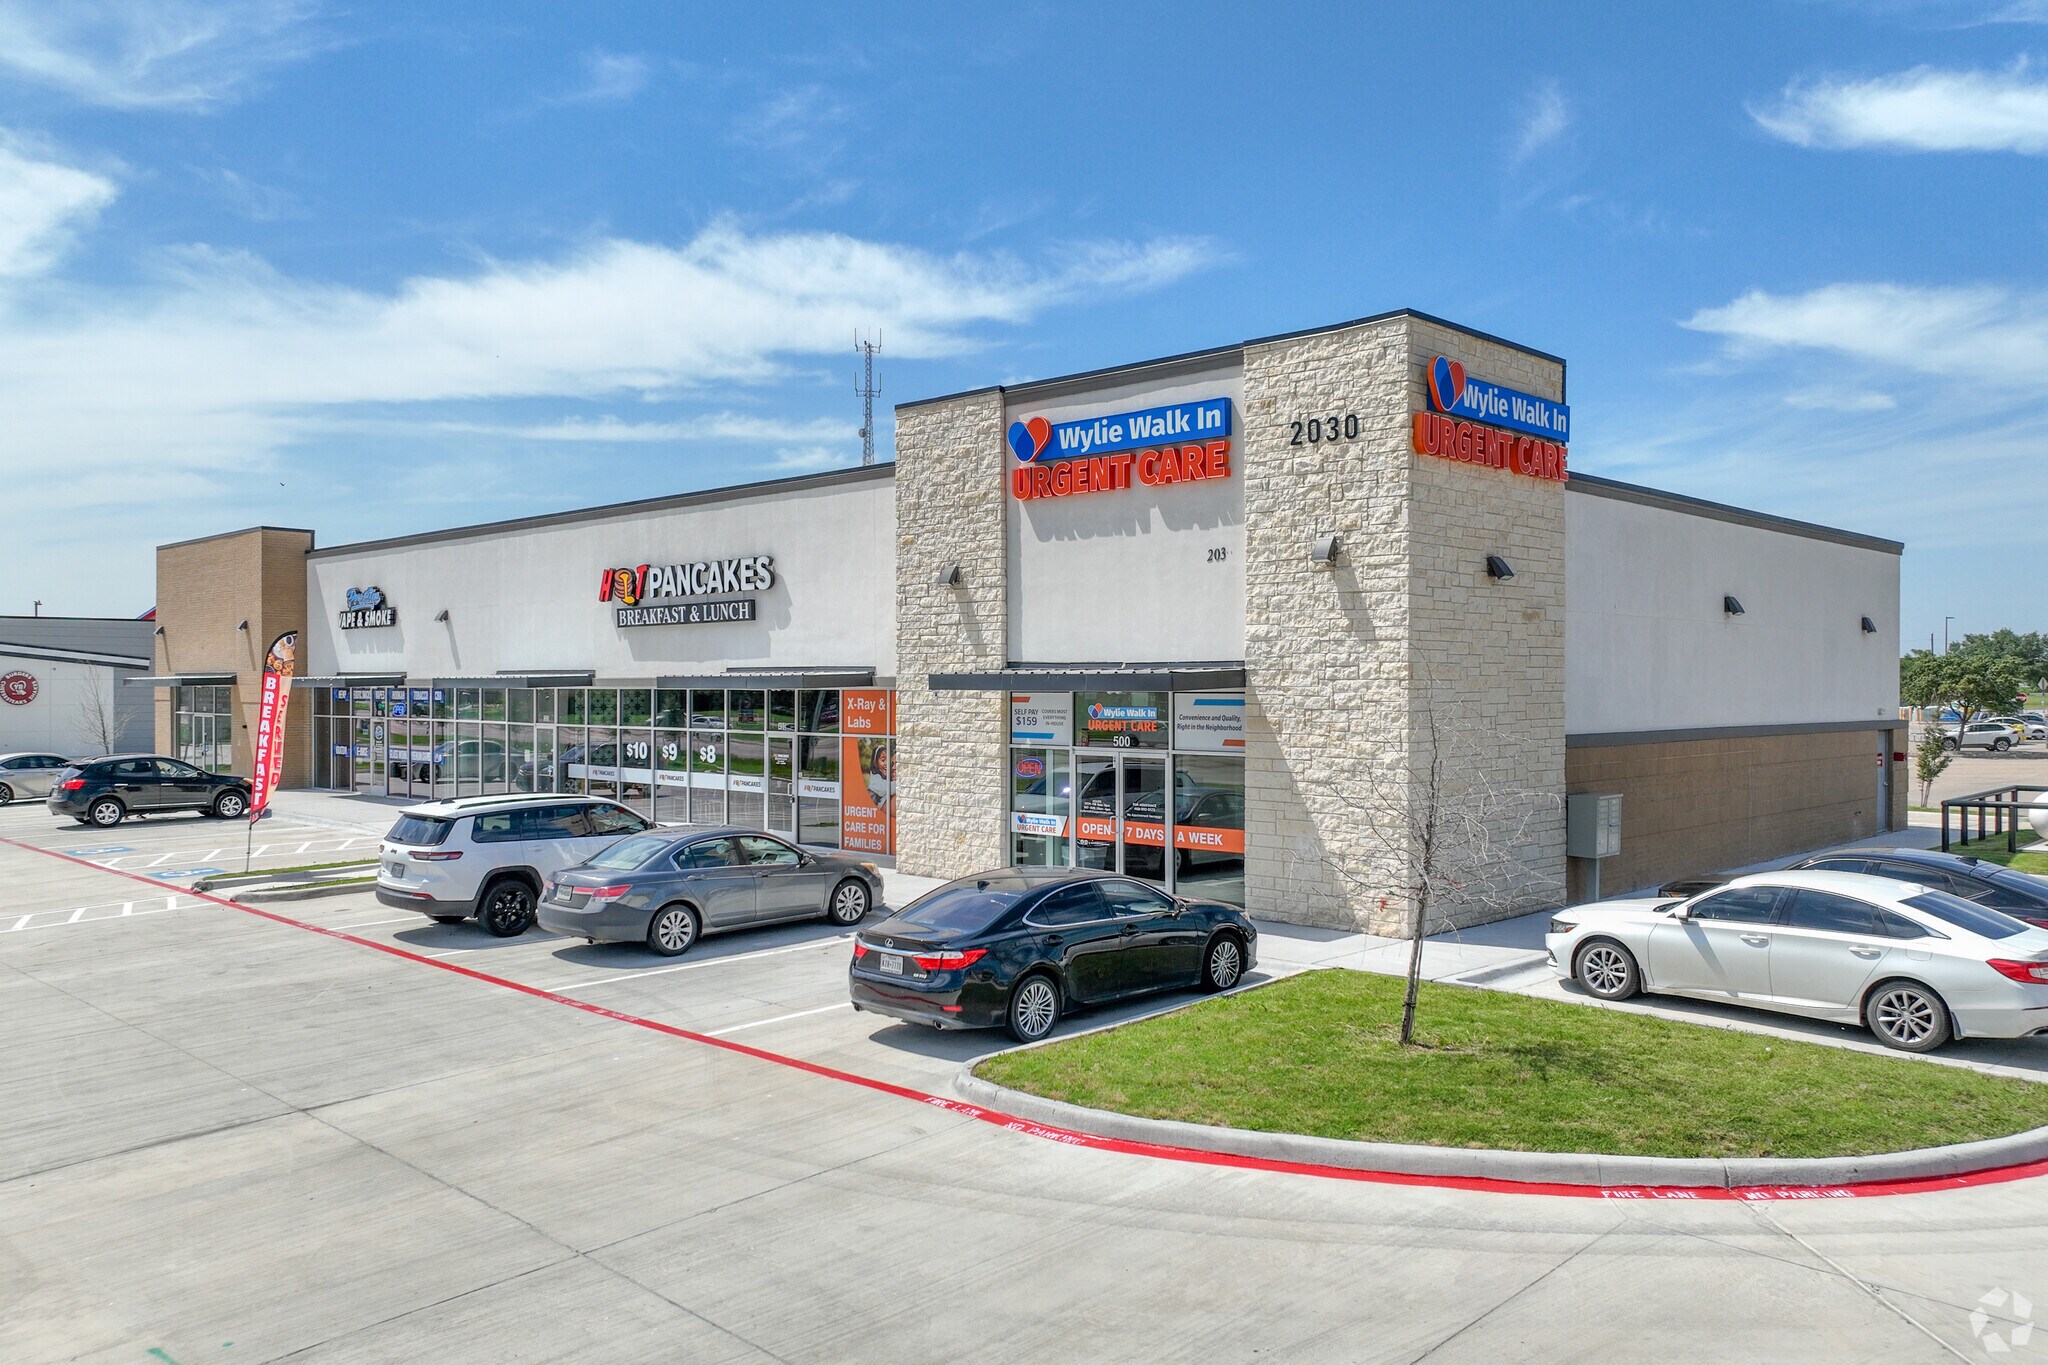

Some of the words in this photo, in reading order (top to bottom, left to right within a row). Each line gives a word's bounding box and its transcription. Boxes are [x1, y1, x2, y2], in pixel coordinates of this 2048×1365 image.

[1463, 384, 1508, 418] Wylie
[1512, 396, 1550, 429] Walk
[1553, 408, 1567, 433] In
[1059, 419, 1123, 453] Wylie
[1129, 410, 1190, 439] Walk
[1197, 406, 1221, 430] In
[1291, 414, 1358, 445] 2030
[1417, 412, 1514, 470] URGENT
[1514, 436, 1569, 482] CARE
[1012, 453, 1136, 500] URGENT
[1138, 441, 1231, 487] CARE
[1206, 547, 1227, 562] 203
[650, 555, 775, 599] PANCAKES
[357, 611, 363, 628] &
[364, 610, 391, 627] SMOKE
[618, 606, 686, 627] BREAKFAST
[689, 605, 700, 622] &
[702, 602, 750, 622] LUNCH
[847, 697, 876, 713] X-Ray
[878, 697, 886, 711] &
[1014, 708, 1028, 716] SELF
[1028, 708, 1039, 716] PAY
[1104, 708, 1126, 718] Wylie
[1127, 707, 1146, 717] Walk
[1148, 708, 1156, 717] In
[847, 715, 872, 729] Labs
[1016, 716, 1038, 726] $159
[1088, 720, 1128, 731] URGENT
[1130, 721, 1157, 732] CARE
[1177, 723, 1190, 731] Right
[1206, 724, 1242, 732] Neighborhood
[253, 676, 277, 806] BREAKFAST
[270, 694, 288, 787] SERVED
[1112, 735, 1131, 748] 500
[626, 741, 648, 760] $10
[662, 743, 678, 761] $9
[700, 744, 716, 763] $8
[1017, 761, 1042, 775] OPEN
[741, 780, 761, 788] PANCAKES
[844, 805, 878, 819] URGENT
[844, 821, 866, 834] CARE
[868, 823, 886, 836] FOR
[1017, 824, 1040, 832] URGENT
[1041, 825, 1057, 833] CARE
[1082, 822, 1112, 836] OPEN
[1126, 826, 1133, 838] 7
[1136, 828, 1165, 841] DAYS
[1177, 831, 1185, 843] A
[1189, 833, 1223, 846] WEEK
[844, 836, 882, 850] FAMILIES
[924, 1096, 953, 1109] FIRE
[1003, 1121, 1026, 1132] NO
[1602, 1190, 1645, 1200] FIRE
[1651, 1190, 1700, 1200] LANE
[1743, 1191, 1771, 1200] NO
[1775, 1189, 1856, 1200] PARKING
